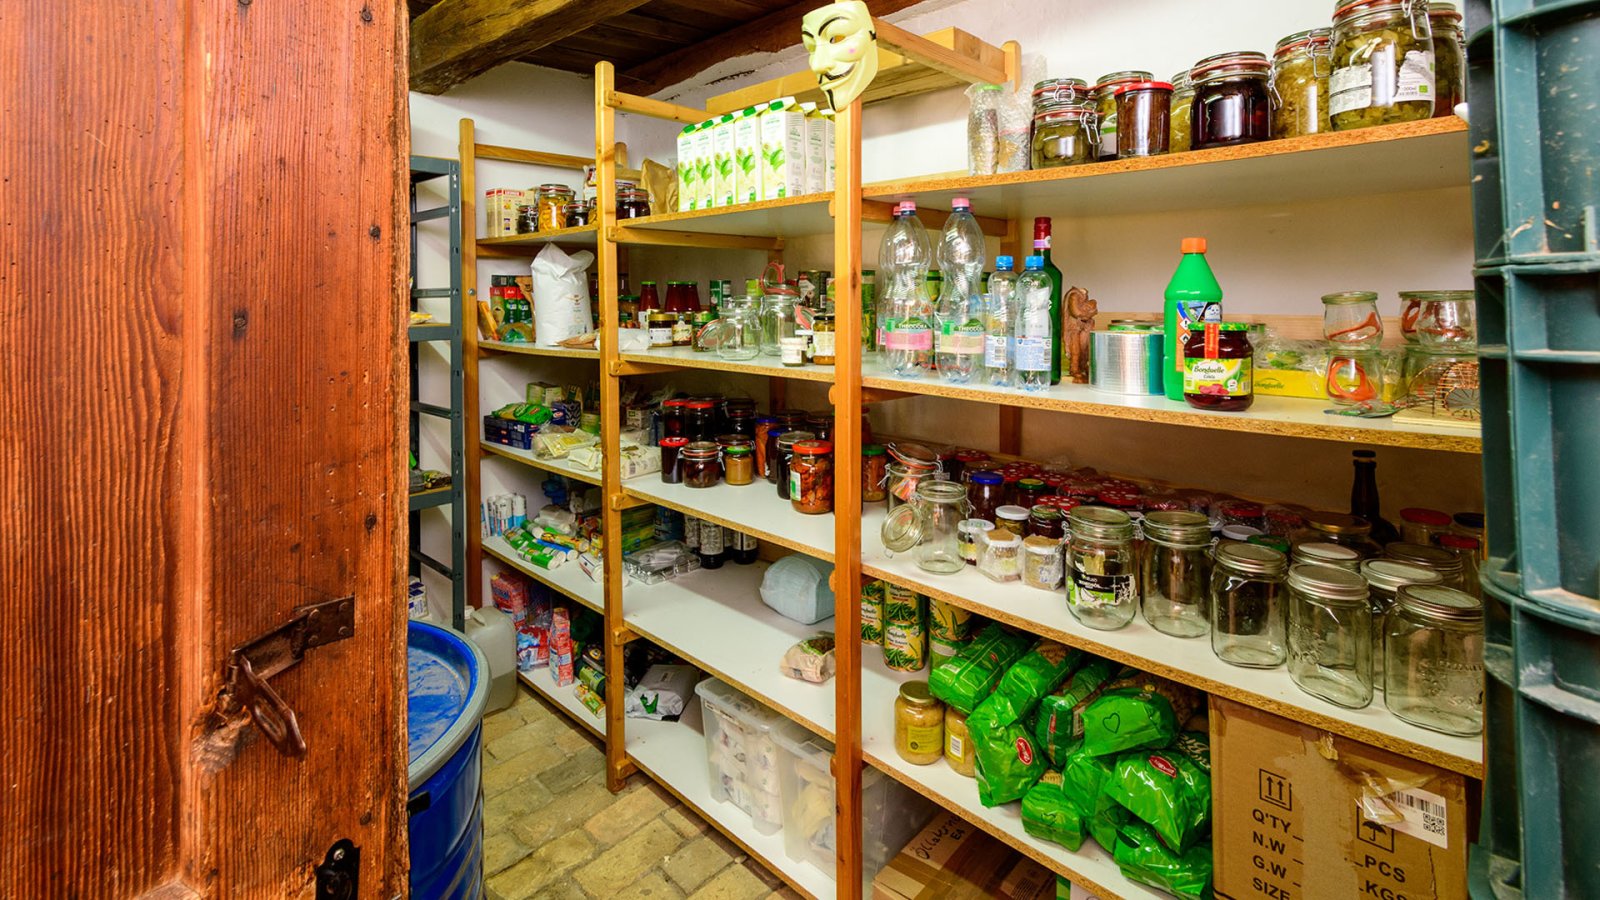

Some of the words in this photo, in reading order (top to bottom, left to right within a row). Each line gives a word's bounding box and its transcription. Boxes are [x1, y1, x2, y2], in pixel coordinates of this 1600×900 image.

[1194, 365, 1225, 374] Bonduelle
[1252, 809, 1291, 833] Q'TY
[1364, 854, 1406, 883] PCS
[1252, 855, 1287, 879] G.W
[1253, 831, 1286, 855] N.W
[1365, 880, 1407, 900] KG
